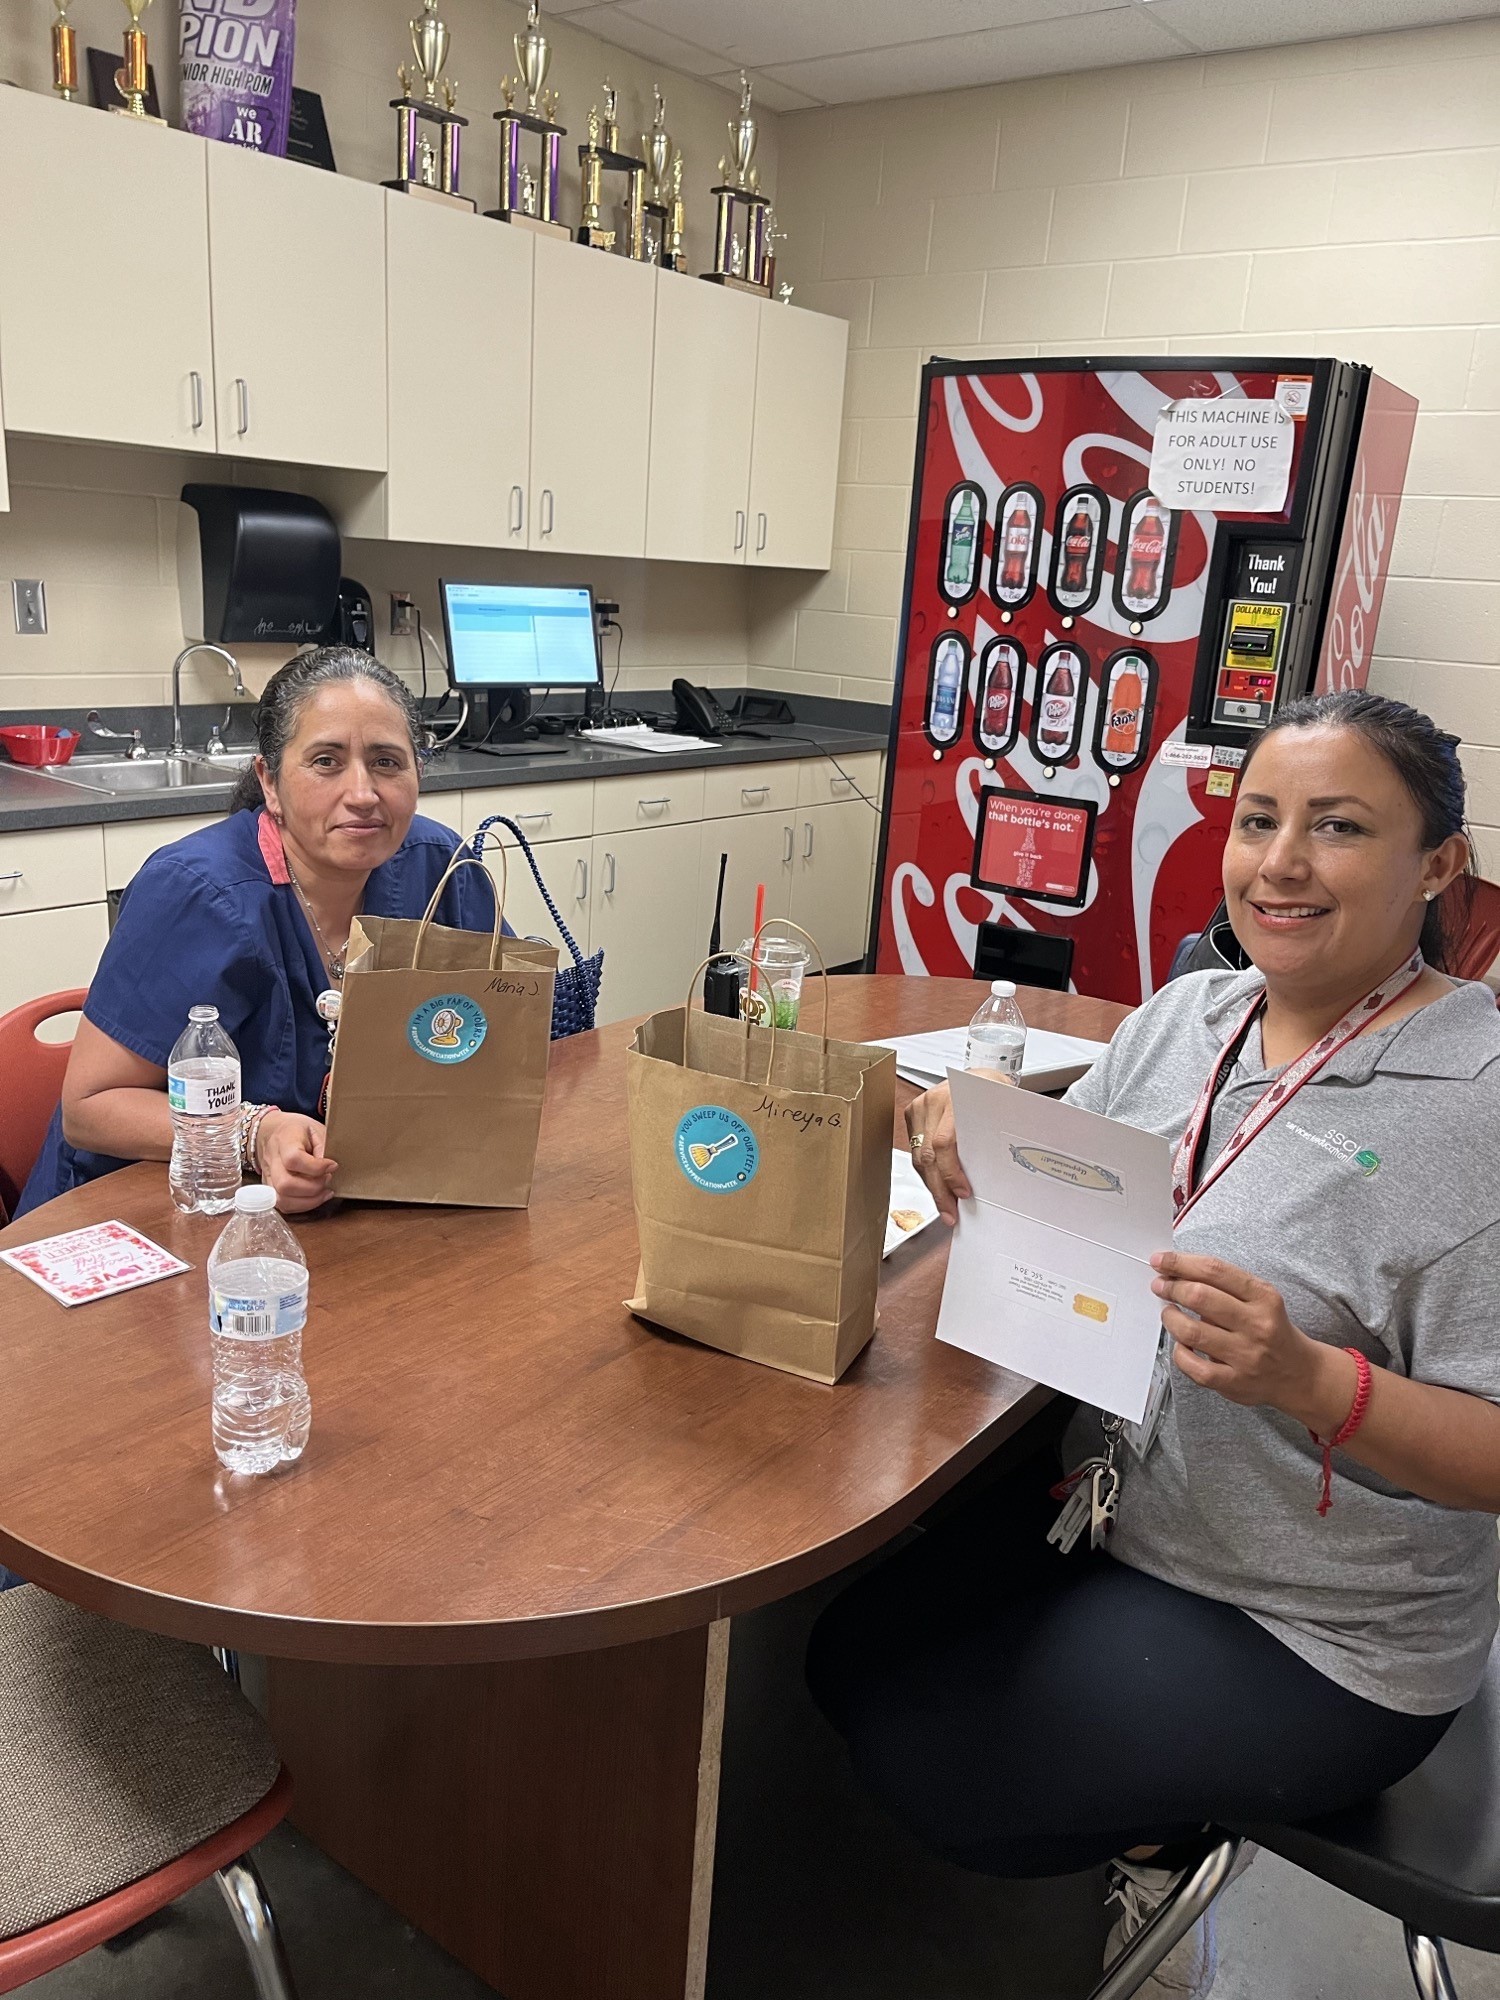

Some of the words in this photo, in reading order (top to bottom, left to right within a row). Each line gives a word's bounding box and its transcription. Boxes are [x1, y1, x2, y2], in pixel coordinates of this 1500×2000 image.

[210, 65, 240, 88] HIGH
[244, 75, 273, 95] POM
[236, 106, 257, 118] we
[228, 119, 262, 144] AR
[1168, 410, 1197, 423] THIS
[1202, 411, 1270, 424] MACHINE
[1274, 412, 1285, 424] IS
[1168, 435, 1195, 448] FOR
[1200, 436, 1248, 448] ADULT
[1251, 436, 1278, 449] USE
[1183, 458, 1225, 471] ONLY!
[1234, 459, 1256, 471] NO
[1177, 480, 1255, 495] STUDENTS!
[1248, 554, 1285, 571] Thank
[1250, 576, 1277, 594] You!
[1235, 606, 1260, 615] DOLLAR
[1262, 607, 1282, 616] BILLS
[990, 800, 1018, 813] When
[1020, 807, 1051, 819] you're
[1054, 810, 1082, 824] done,
[988, 811, 1008, 821] that
[1010, 815, 1050, 829] bottle's
[1052, 822, 1075, 832] not.
[484, 977, 525, 996] Maria
[430, 1000, 444, 1010] BIG
[462, 1002, 474, 1010] OF
[472, 1012, 484, 1038] YOURS
[205, 1080, 236, 1097] THANK
[692, 1110, 716, 1122] SWEEP
[719, 1112, 730, 1122] US
[753, 1095, 823, 1132] Mireya
[681, 1119, 692, 1134] YOU
[730, 1120, 746, 1134] OFF
[743, 1136, 754, 1152] OUR
[1324, 1130, 1357, 1152] SSC
[744, 1154, 754, 1174] FEET
[90, 1236, 111, 1246] SO
